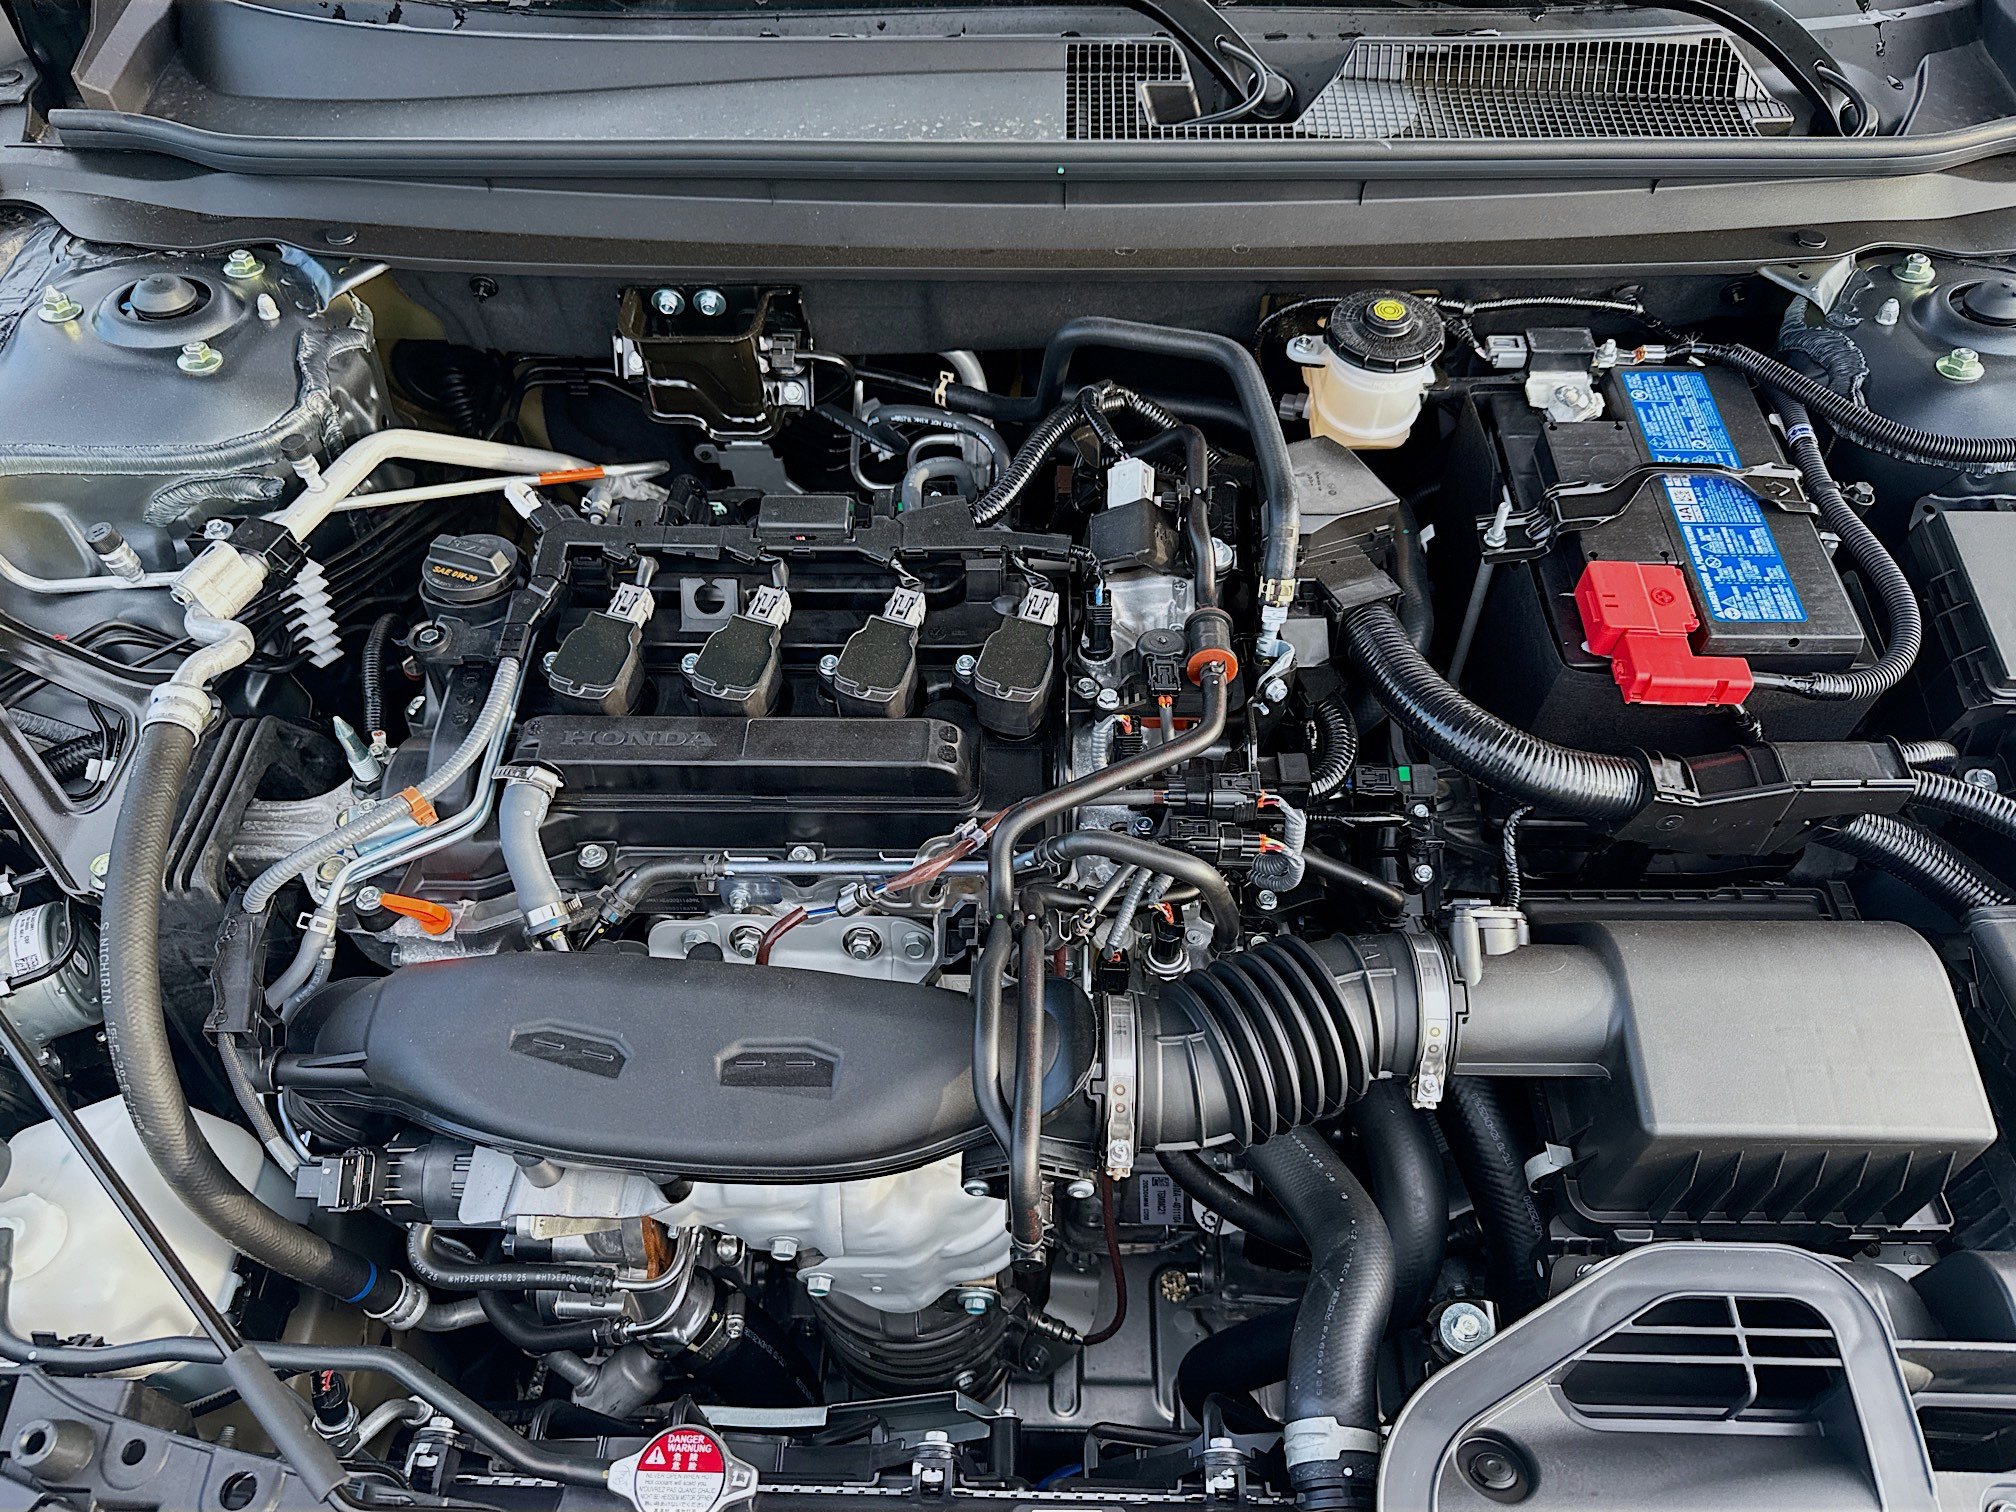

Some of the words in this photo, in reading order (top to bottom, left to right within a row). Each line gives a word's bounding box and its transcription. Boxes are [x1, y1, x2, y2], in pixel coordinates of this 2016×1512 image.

[1679, 507, 1693, 520] 4A
[432, 565, 453, 576] SAE
[451, 571, 478, 582] 0W-20
[560, 730, 717, 747] HONDA
[413, 1261, 426, 1274] 259
[427, 1272, 439, 1282] 25
[498, 1273, 513, 1282] 259
[516, 1273, 527, 1282] 25
[667, 1434, 705, 1444] DANGER
[667, 1443, 712, 1453] WARNUNG
